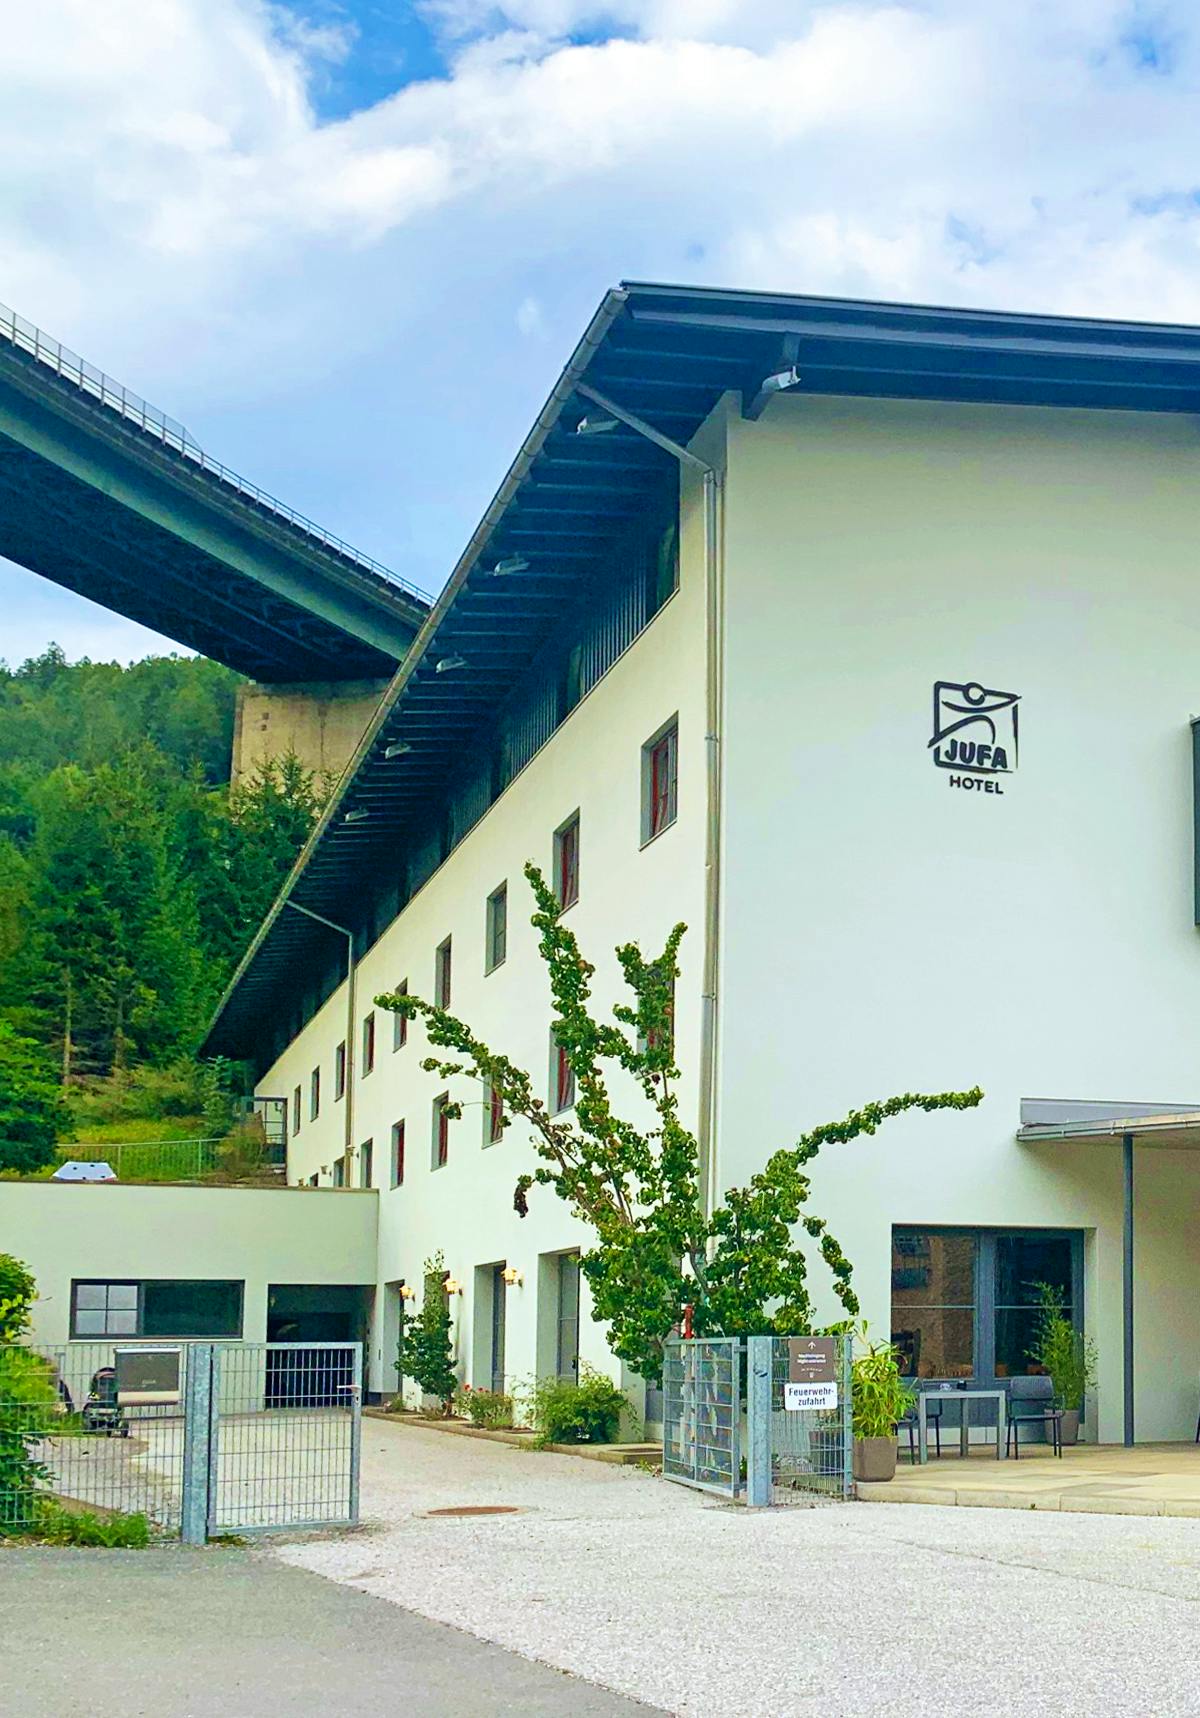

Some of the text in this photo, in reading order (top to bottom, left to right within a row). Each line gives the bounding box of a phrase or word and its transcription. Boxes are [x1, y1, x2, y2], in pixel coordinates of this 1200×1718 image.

[944, 738, 1008, 769] JUFA
[949, 775, 1004, 795] HOTEL
[788, 1387, 834, 1396] Feuerwehr-
[798, 1397, 826, 1406] zufahrt
